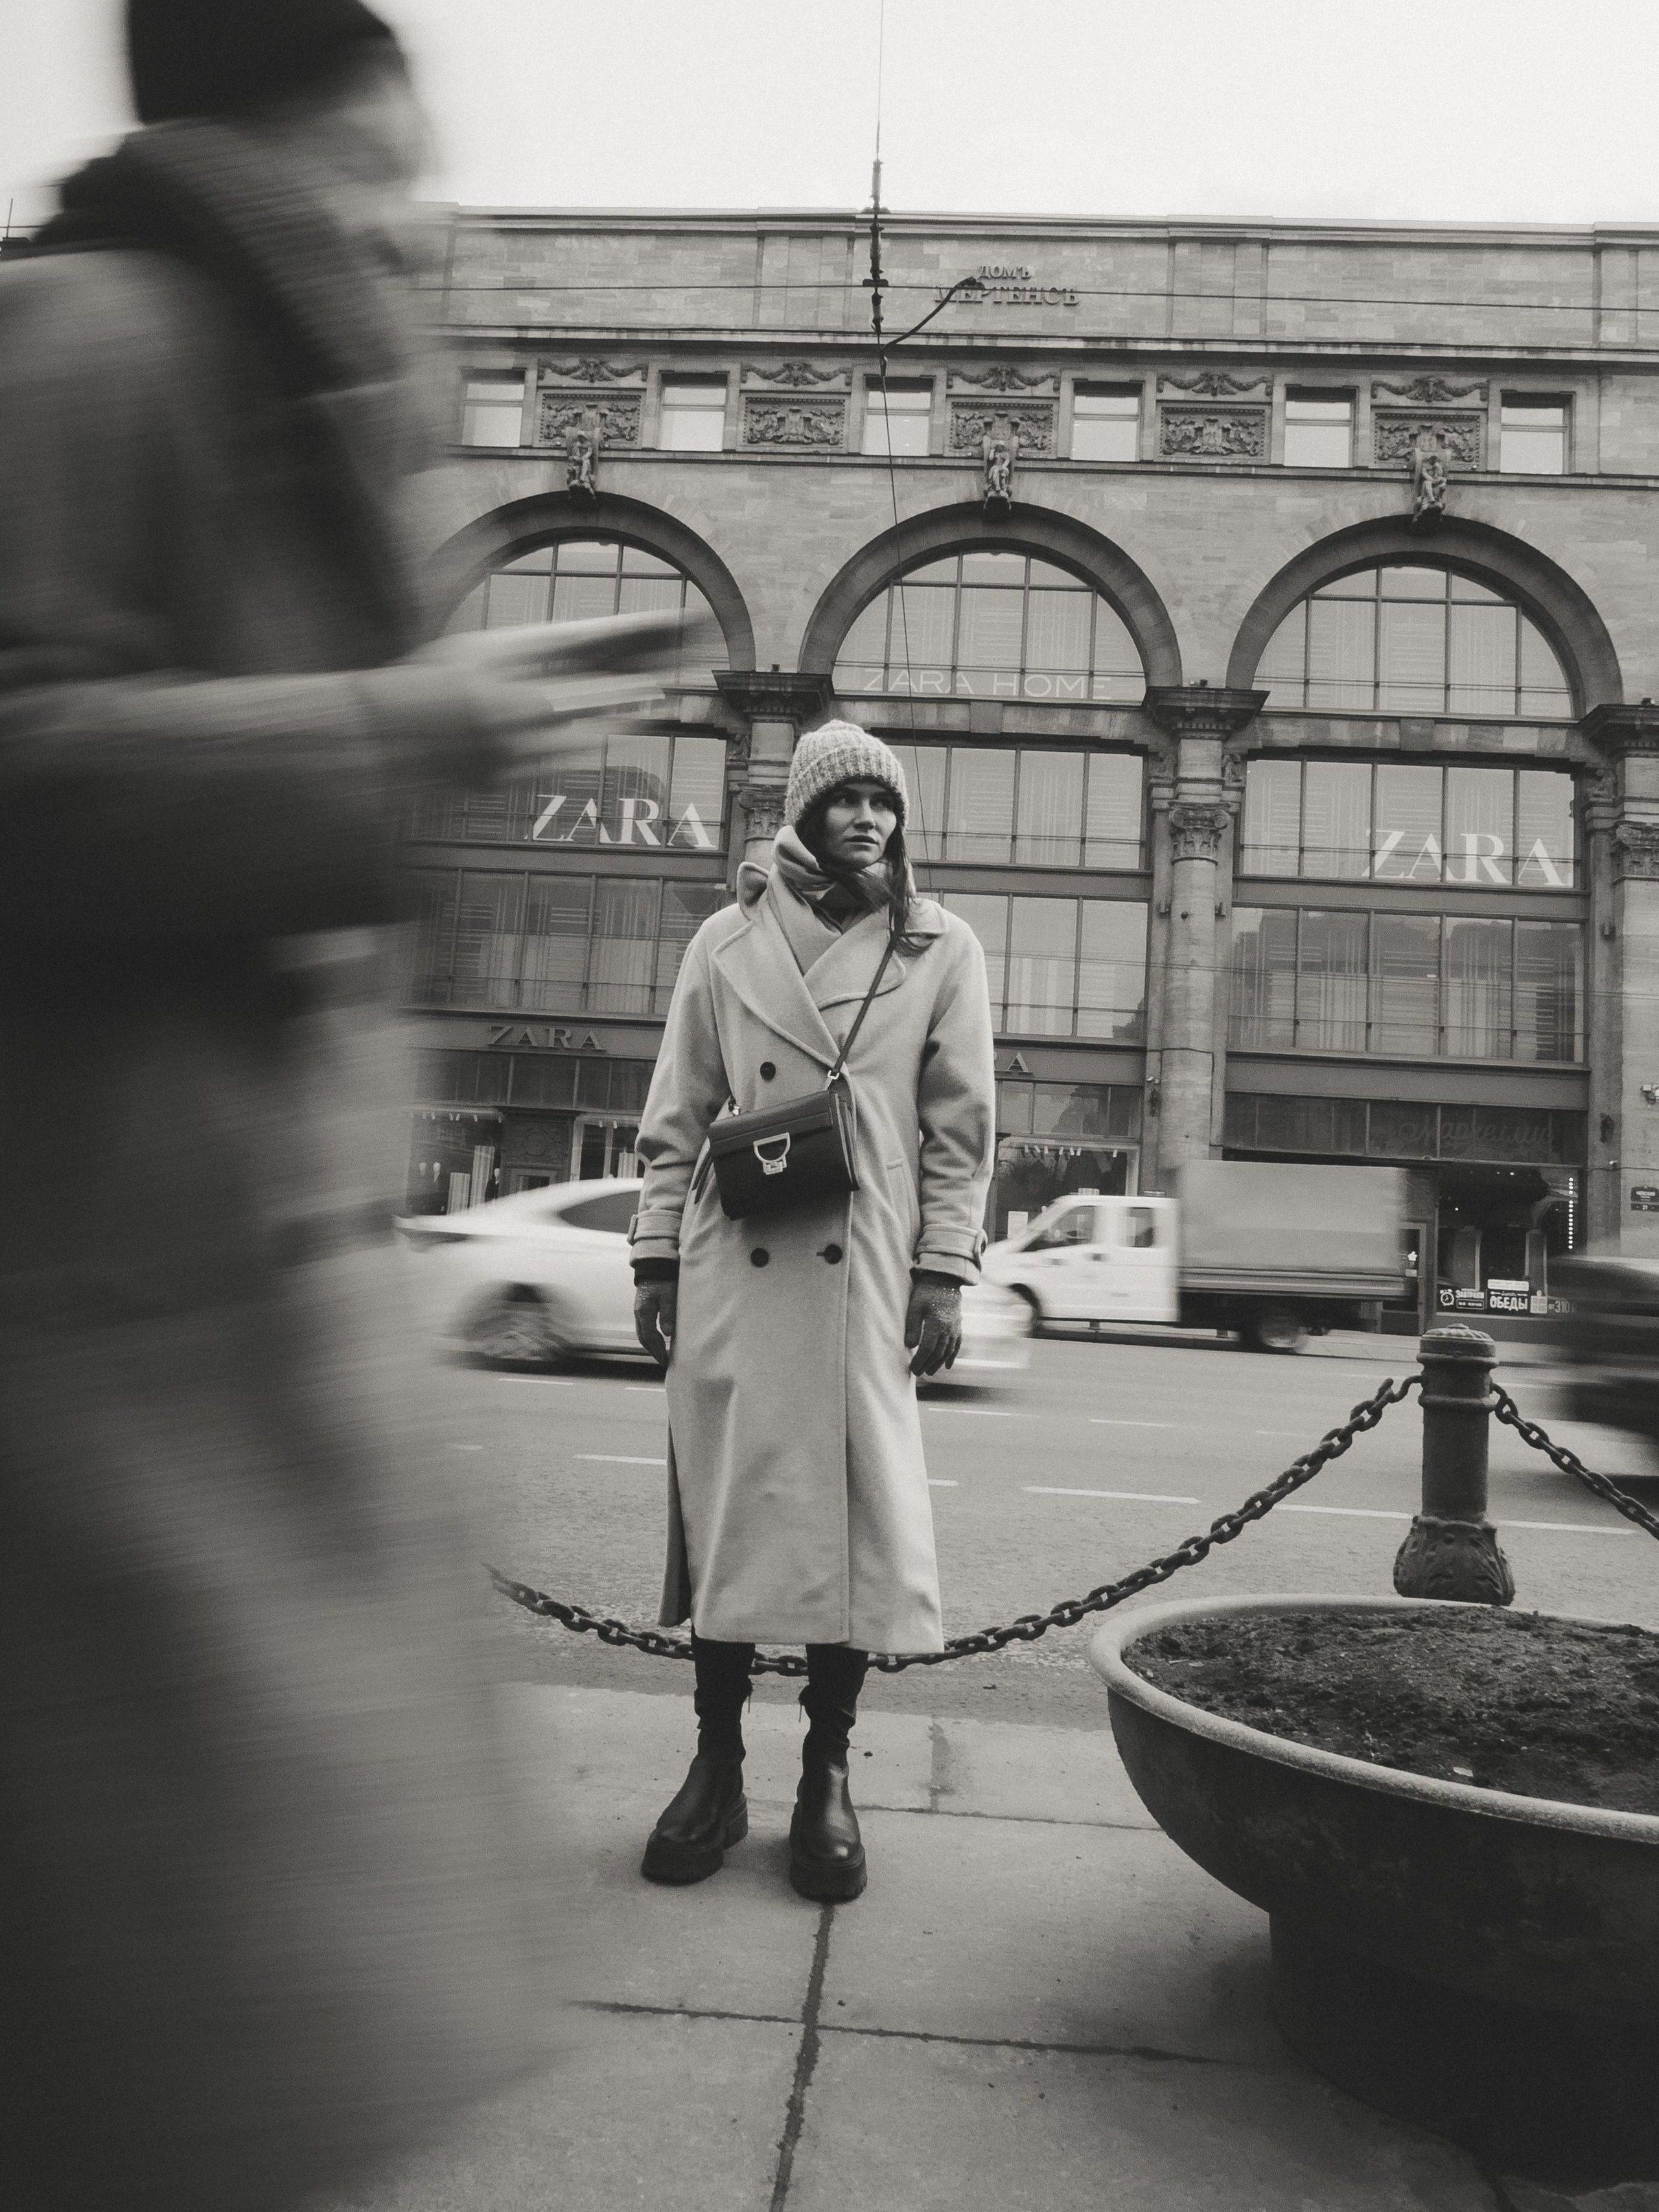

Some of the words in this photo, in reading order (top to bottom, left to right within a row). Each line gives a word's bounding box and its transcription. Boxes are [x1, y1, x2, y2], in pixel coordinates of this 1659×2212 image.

[978, 265, 1032, 280] ДОМЪ
[863, 669, 973, 694] ZARA
[993, 673, 1112, 700] HOME
[524, 793, 717, 848] ZARA
[1362, 829, 1566, 887] ZARA
[486, 1025, 606, 1051] ZARA
[1490, 1295, 1528, 1311] ОБЕДЫ
